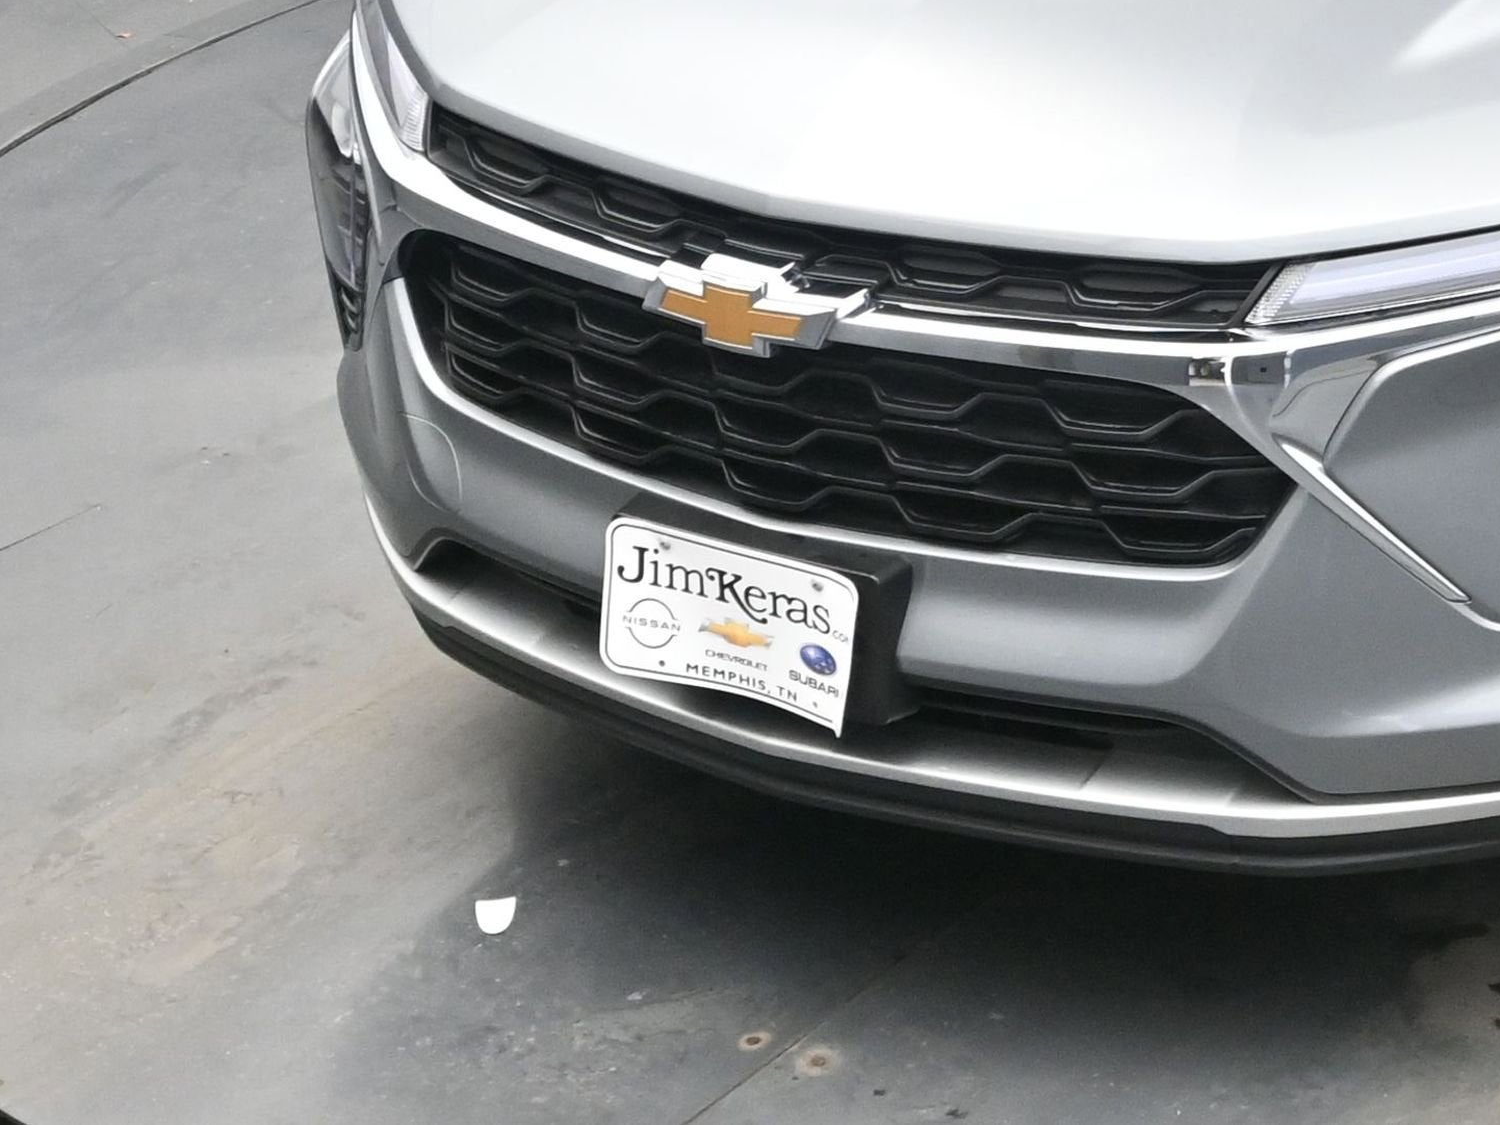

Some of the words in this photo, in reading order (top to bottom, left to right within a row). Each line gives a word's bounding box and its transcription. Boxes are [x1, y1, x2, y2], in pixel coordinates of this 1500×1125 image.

[622, 615, 680, 632] NISSAN
[705, 649, 768, 671] CHEVROLET
[685, 663, 771, 694] MEMPHIS,
[776, 685, 797, 701] TN
